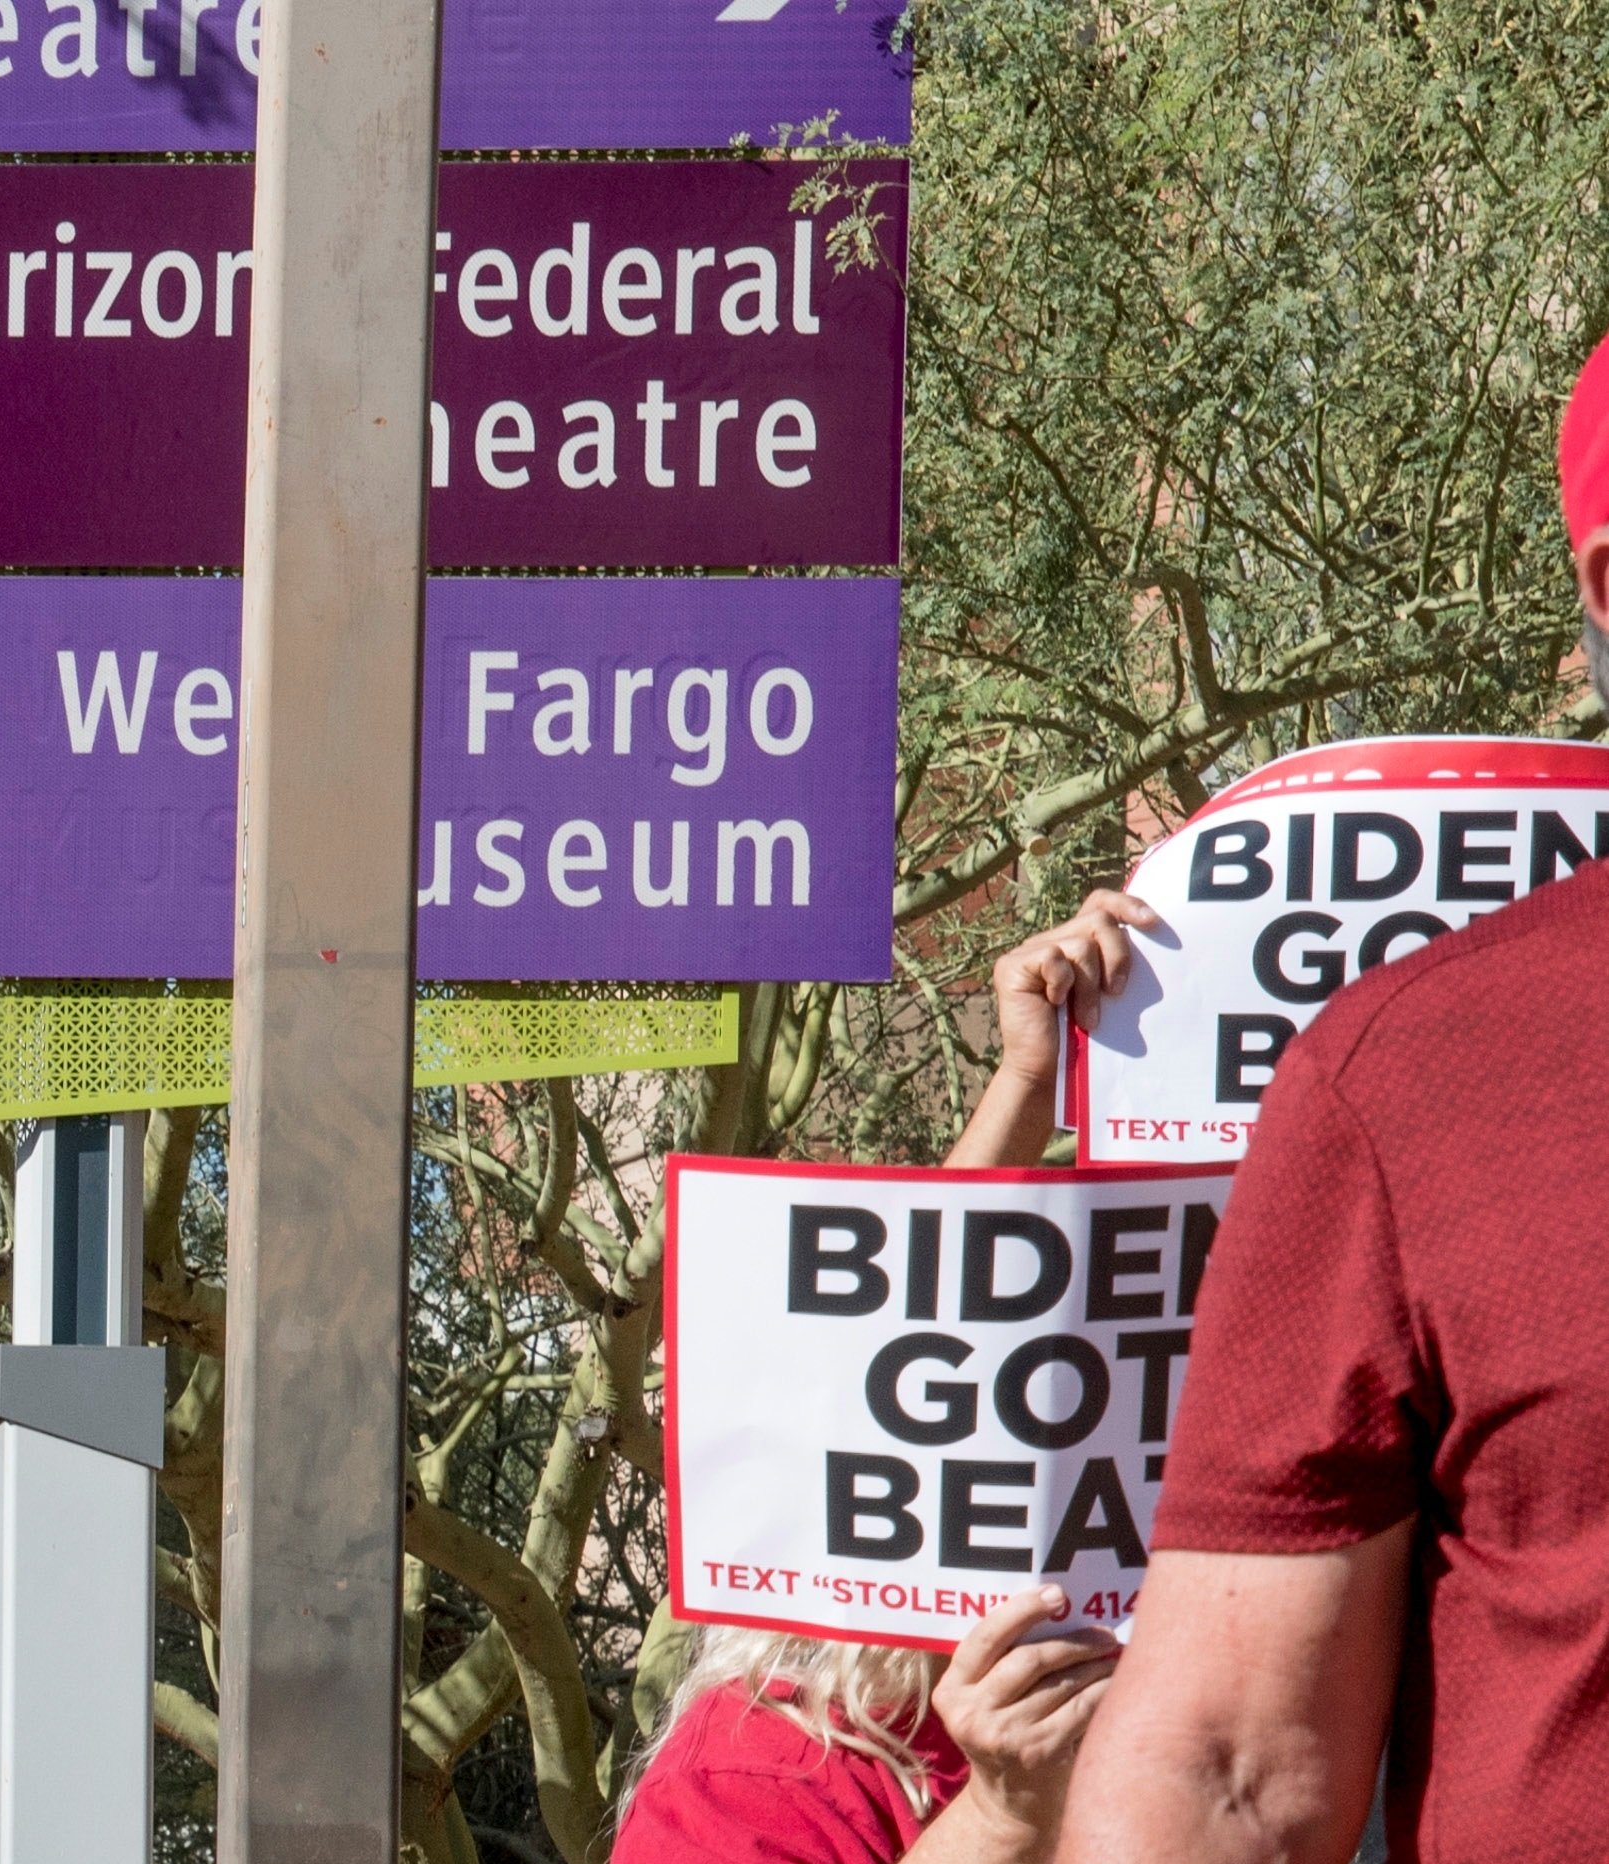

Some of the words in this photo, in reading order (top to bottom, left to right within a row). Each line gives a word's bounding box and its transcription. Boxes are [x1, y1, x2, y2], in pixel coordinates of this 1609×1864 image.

[430, 380, 817, 489] eatre
[467, 650, 814, 787] Fargo
[417, 819, 811, 908] useum
[1252, 910, 1492, 1005] GO
[1106, 1118, 1191, 1142] TEXT
[864, 1328, 1191, 1451] GOT
[825, 1450, 1167, 1574] BEA
[702, 1560, 800, 1596] TEXT
[812, 1573, 1009, 1618] “STOLEN”
